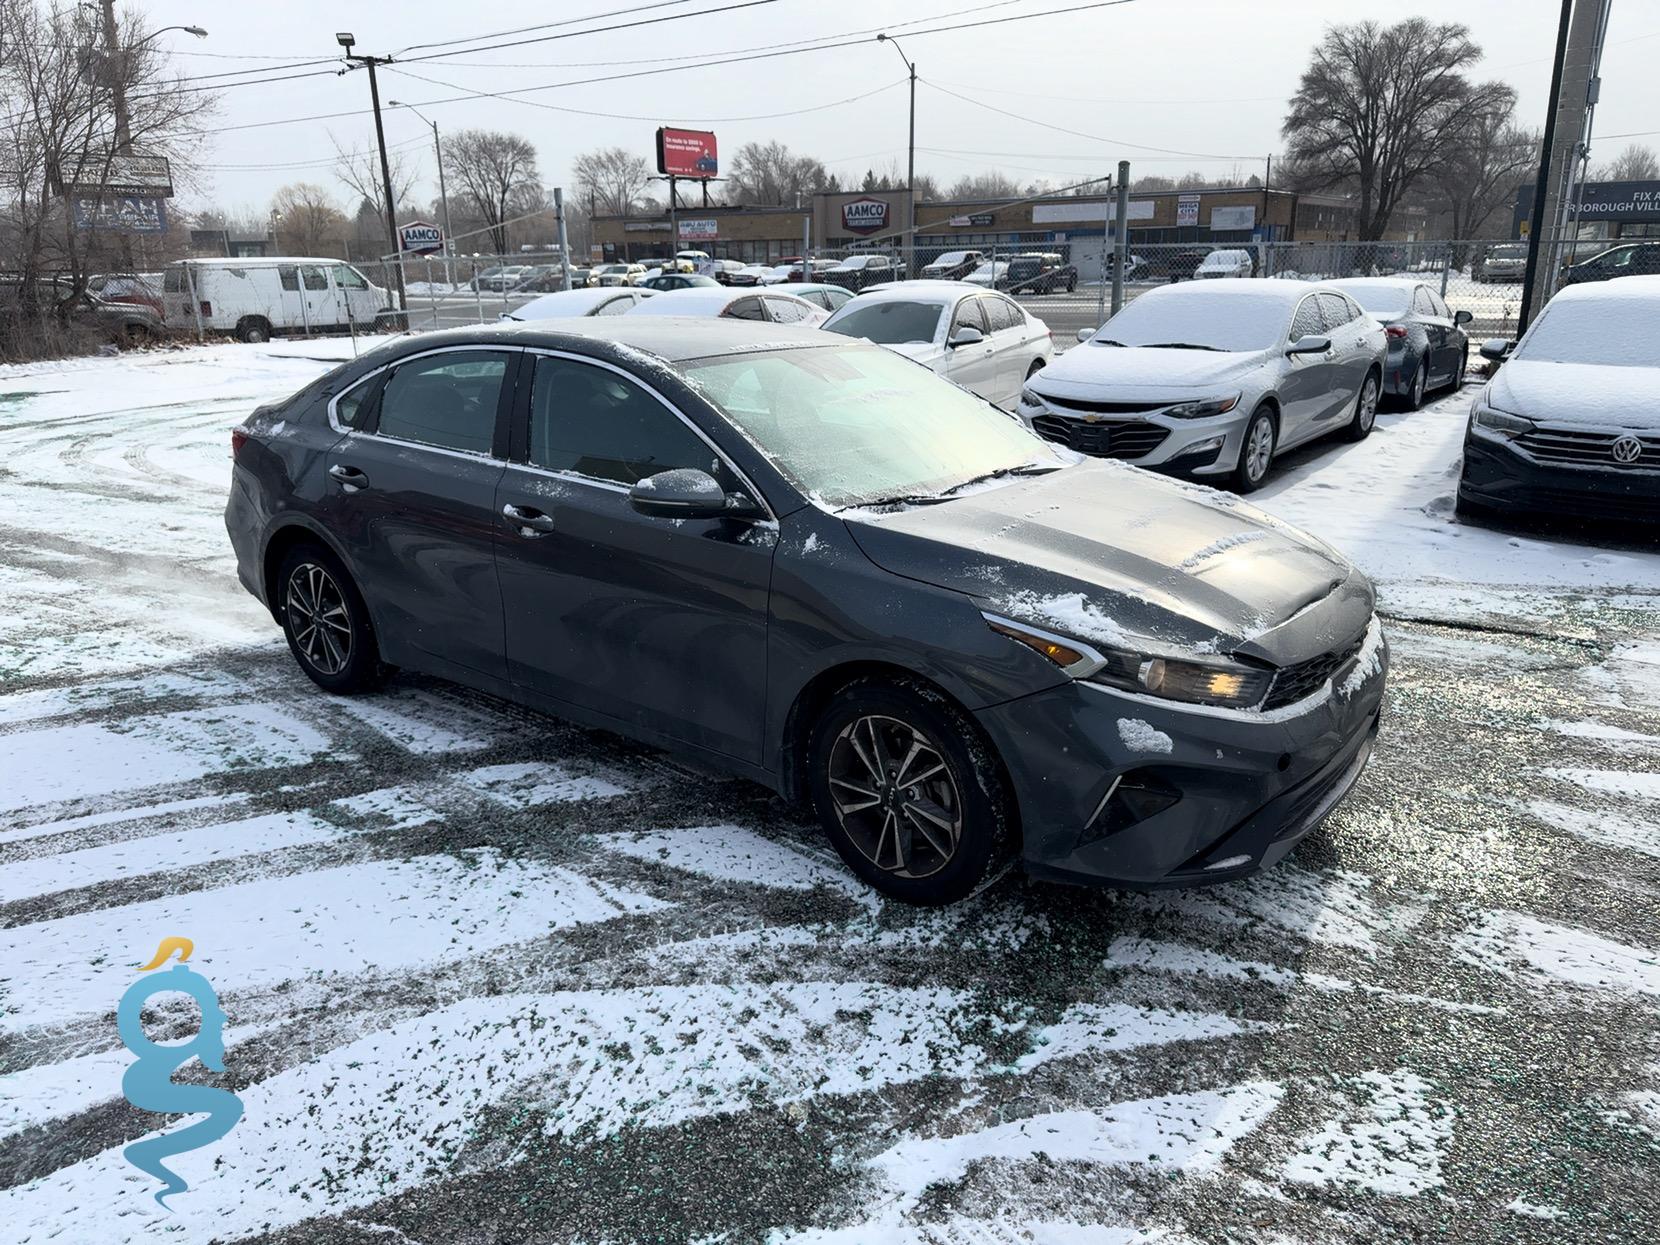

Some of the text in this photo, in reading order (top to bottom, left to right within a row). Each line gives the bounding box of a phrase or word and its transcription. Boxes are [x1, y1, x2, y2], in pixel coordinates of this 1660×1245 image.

[1633, 192, 1651, 201] FIX
[846, 203, 884, 217] AAMCO
[1569, 202, 1634, 212] RBOROUGH
[405, 229, 439, 240] AAMCO
